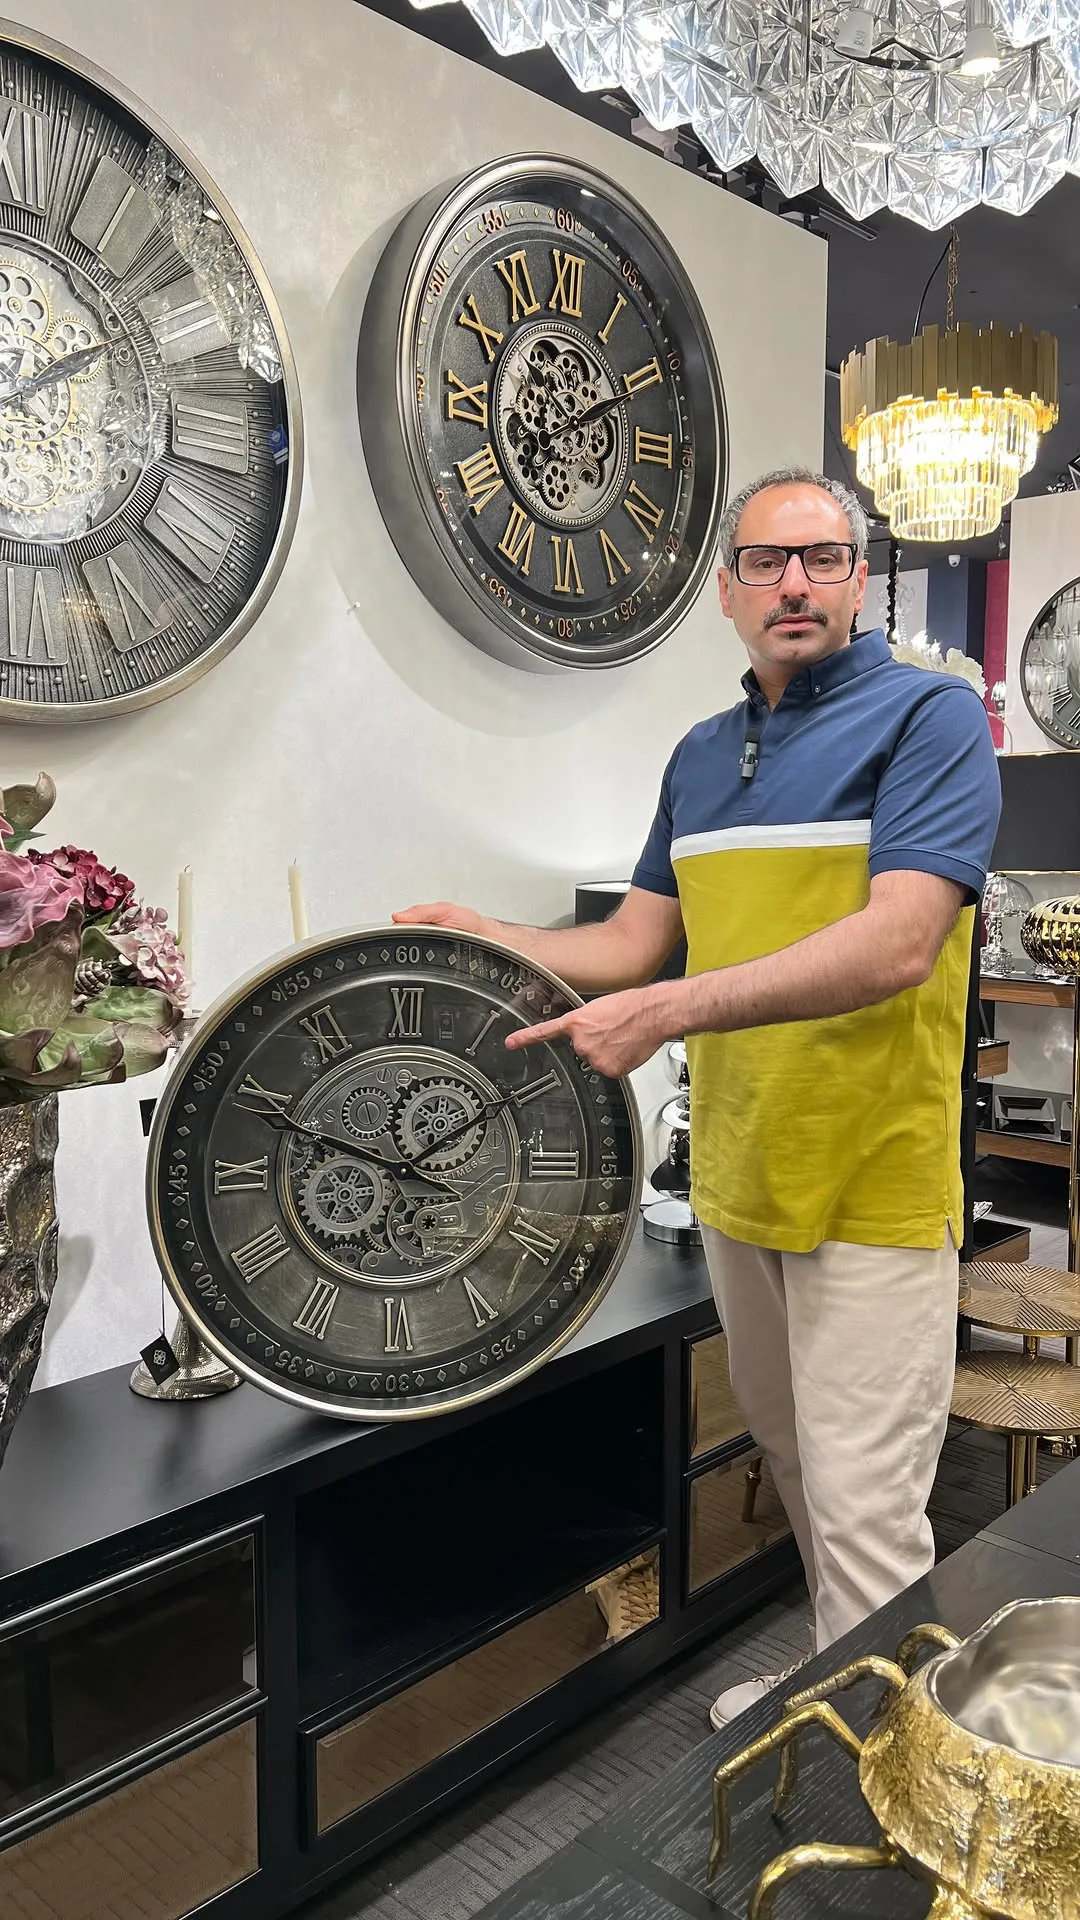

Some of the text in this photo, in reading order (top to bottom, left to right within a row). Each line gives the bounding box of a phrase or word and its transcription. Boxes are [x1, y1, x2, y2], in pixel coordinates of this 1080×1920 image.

[484, 207, 505, 235] 55
[555, 208, 574, 233] 60
[496, 249, 541, 323] XI
[548, 248, 585, 318] XII
[621, 259, 638, 286] 05
[458, 294, 504, 362] X
[597, 292, 628, 344] I
[623, 356, 664, 399] II
[665, 350, 680, 371] 10
[448, 368, 488, 429] IX
[176, 403, 245, 457] III
[634, 425, 673, 469] III
[456, 442, 506, 516] VIII
[622, 480, 665, 543] IV
[497, 502, 536, 577] VII
[598, 528, 632, 586] V
[550, 535, 585, 595] VI
[106, 556, 161, 641] V
[619, 600, 637, 622] 25
[557, 617, 574, 639] 30
[394, 945, 421, 964] 60
[282, 971, 312, 996] 55
[499, 972, 526, 995] 05
[388, 987, 425, 1038] XII
[464, 1010, 501, 1057] I
[298, 1004, 353, 1065] XI
[198, 1052, 225, 1080] 50
[237, 1073, 293, 1113] X
[513, 1068, 563, 1109] II
[168, 1164, 188, 1191] 45
[214, 1155, 269, 1194] IX
[528, 1150, 580, 1178] III
[600, 1152, 617, 1176] 15
[231, 1222, 291, 1284] VIII
[508, 1214, 560, 1266] IV
[194, 1273, 222, 1298] 40
[461, 1276, 499, 1329] V
[292, 1276, 340, 1341] VII
[384, 1296, 414, 1352] VI
[274, 1350, 303, 1374] 35
[490, 1336, 517, 1361] 25
[384, 1373, 410, 1393] 30
